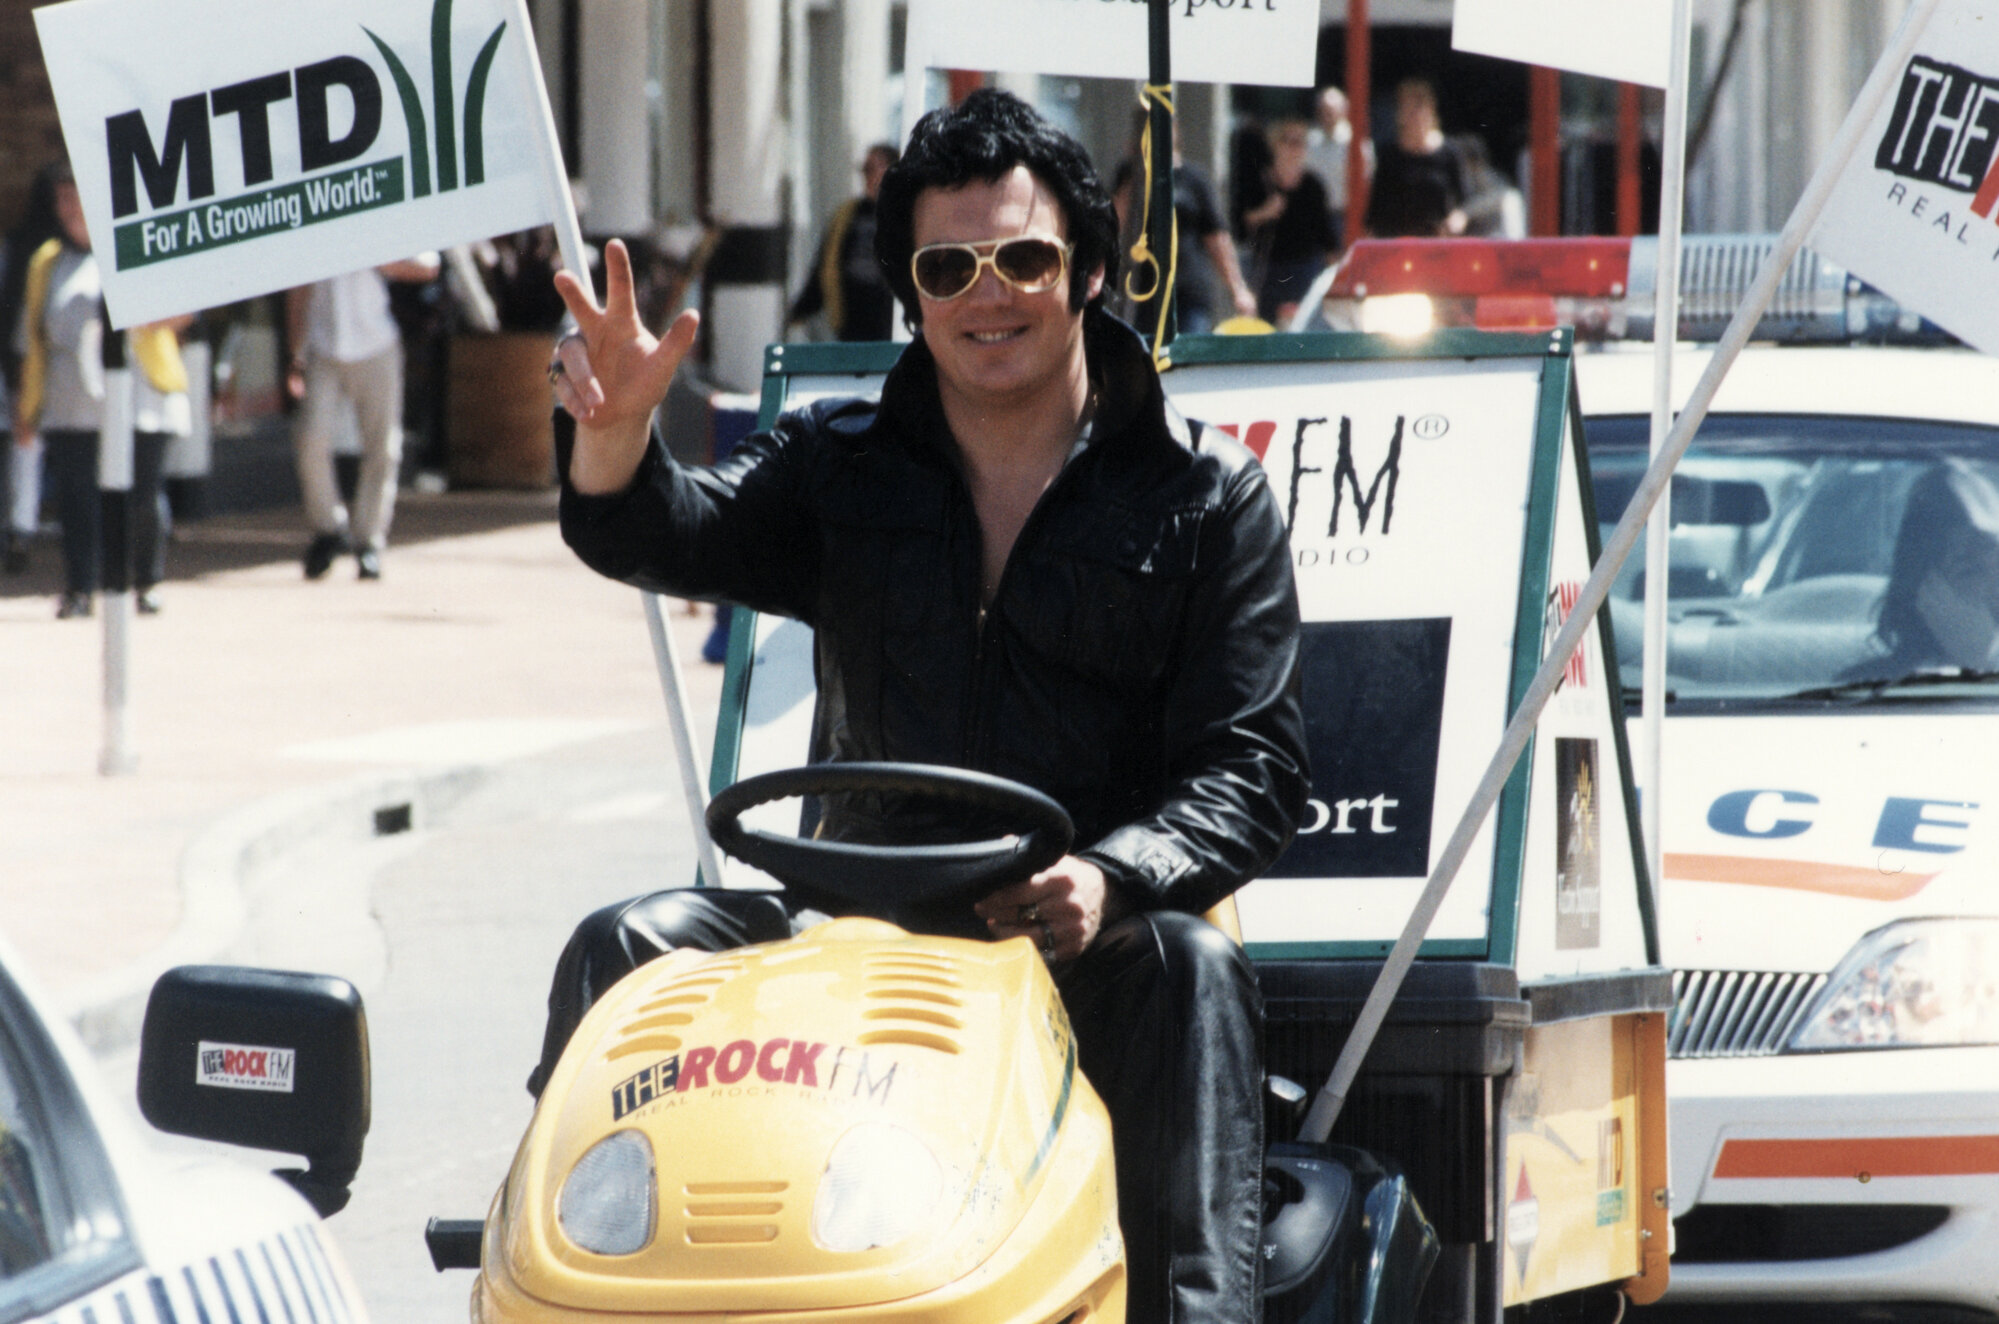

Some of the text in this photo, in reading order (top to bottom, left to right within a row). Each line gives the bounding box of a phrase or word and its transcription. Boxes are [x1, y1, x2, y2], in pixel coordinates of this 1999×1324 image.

[105, 54, 383, 220] MTD
[1891, 63, 1999, 188] THE
[141, 221, 180, 256] For
[186, 211, 203, 246] A
[206, 192, 301, 240] Growing
[1887, 181, 1969, 245] REAL
[1299, 547, 1370, 567] DIO
[203, 1049, 293, 1079] THE ROCK FM
[614, 1038, 899, 1116] THE ROCK FM
[636, 1096, 688, 1121] REAL
[710, 1086, 778, 1098] ROCK
